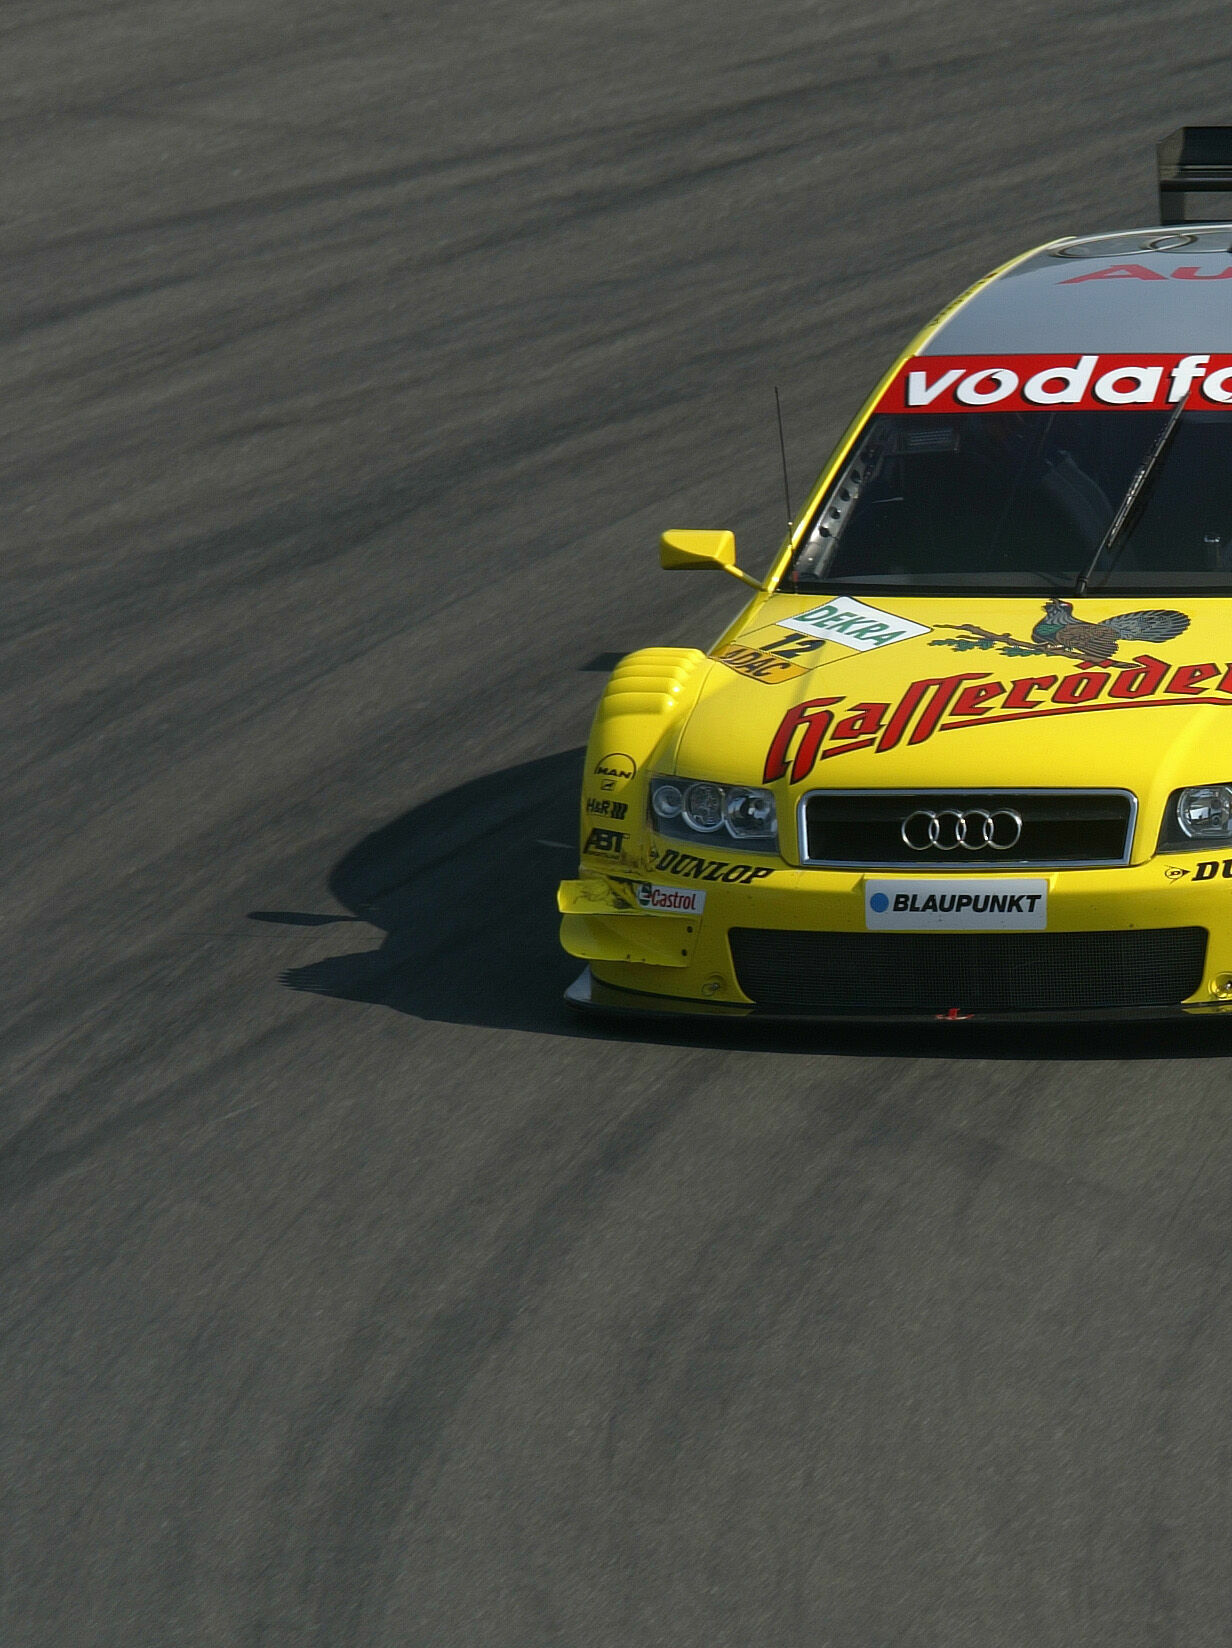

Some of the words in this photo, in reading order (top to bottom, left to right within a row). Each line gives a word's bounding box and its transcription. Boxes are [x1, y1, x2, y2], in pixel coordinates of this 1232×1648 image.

[793, 605, 907, 646] DEKRA
[758, 632, 826, 660] 12
[597, 766, 632, 779] MAN
[583, 828, 626, 854] ABT
[655, 849, 775, 884] DUNLOP
[651, 889, 697, 911] Castrol
[893, 894, 1042, 913] BLAUPUNKT
